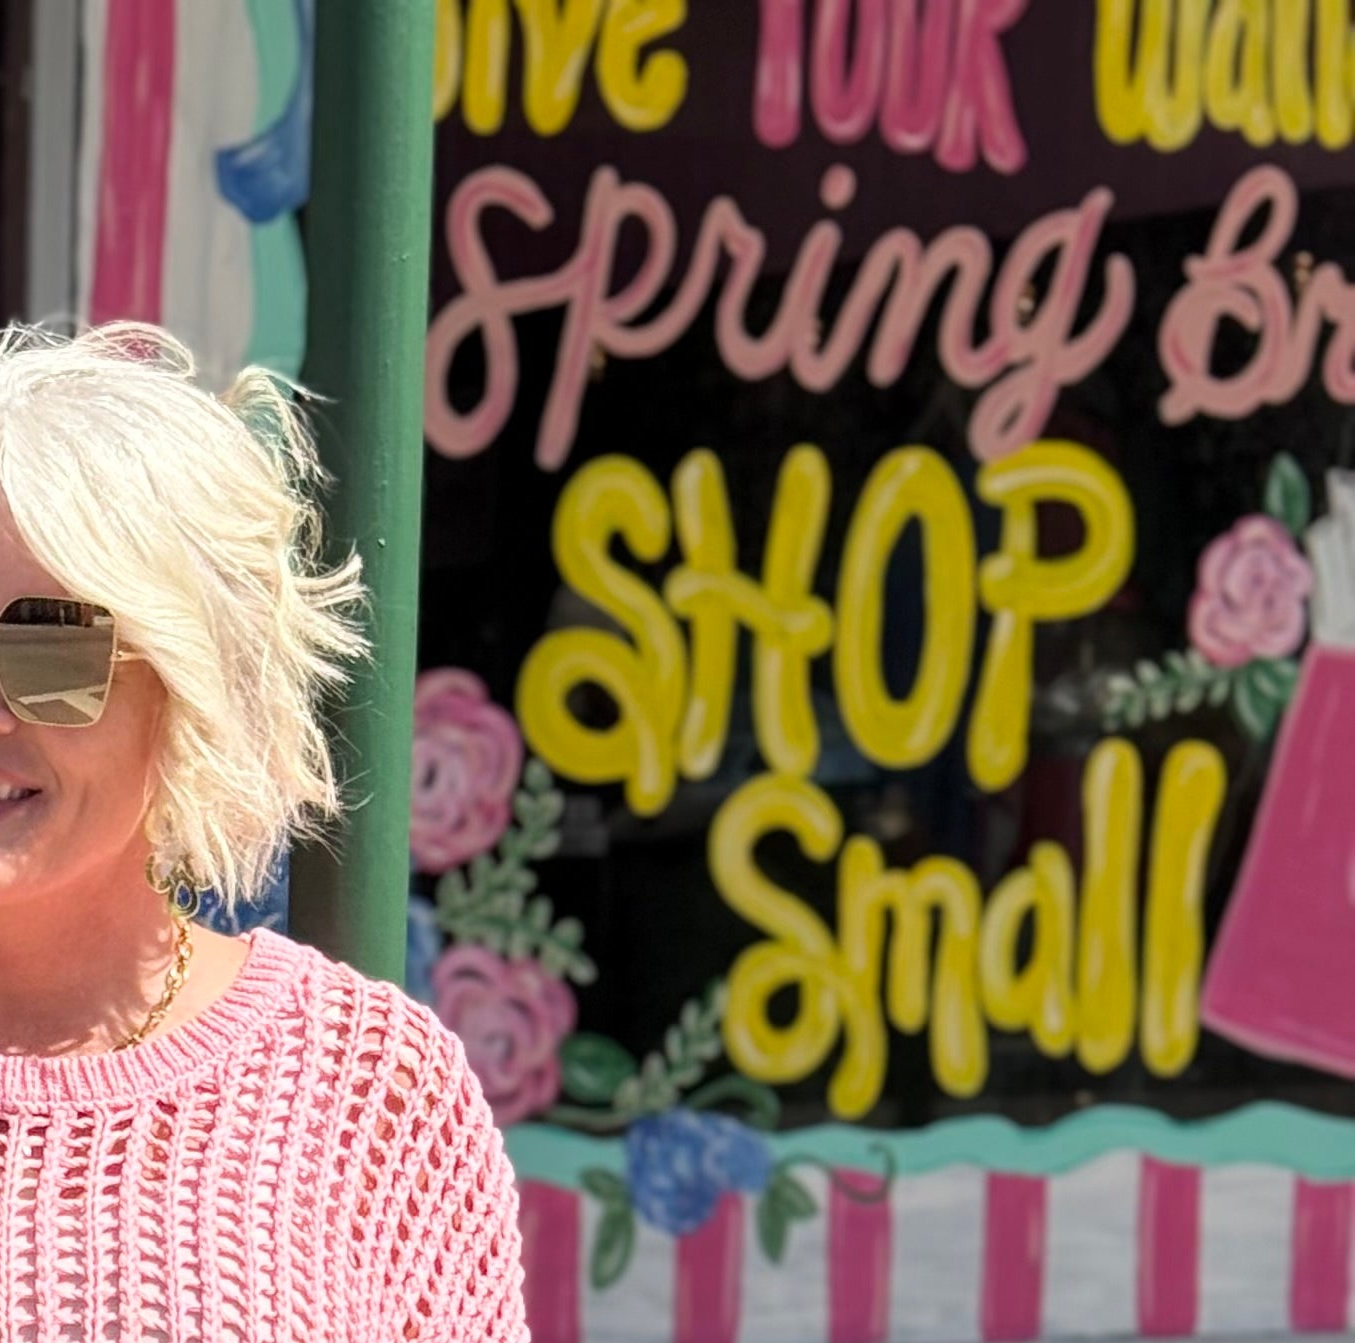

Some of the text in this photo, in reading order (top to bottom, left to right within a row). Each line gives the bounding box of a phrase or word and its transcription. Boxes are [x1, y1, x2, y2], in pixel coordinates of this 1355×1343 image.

[432, 0, 688, 136] ive
[1094, 0, 1355, 151] Wall
[424, 165, 1136, 472] Spring
[515, 439, 1136, 816] SHOP
[708, 738, 1226, 1117] Small
